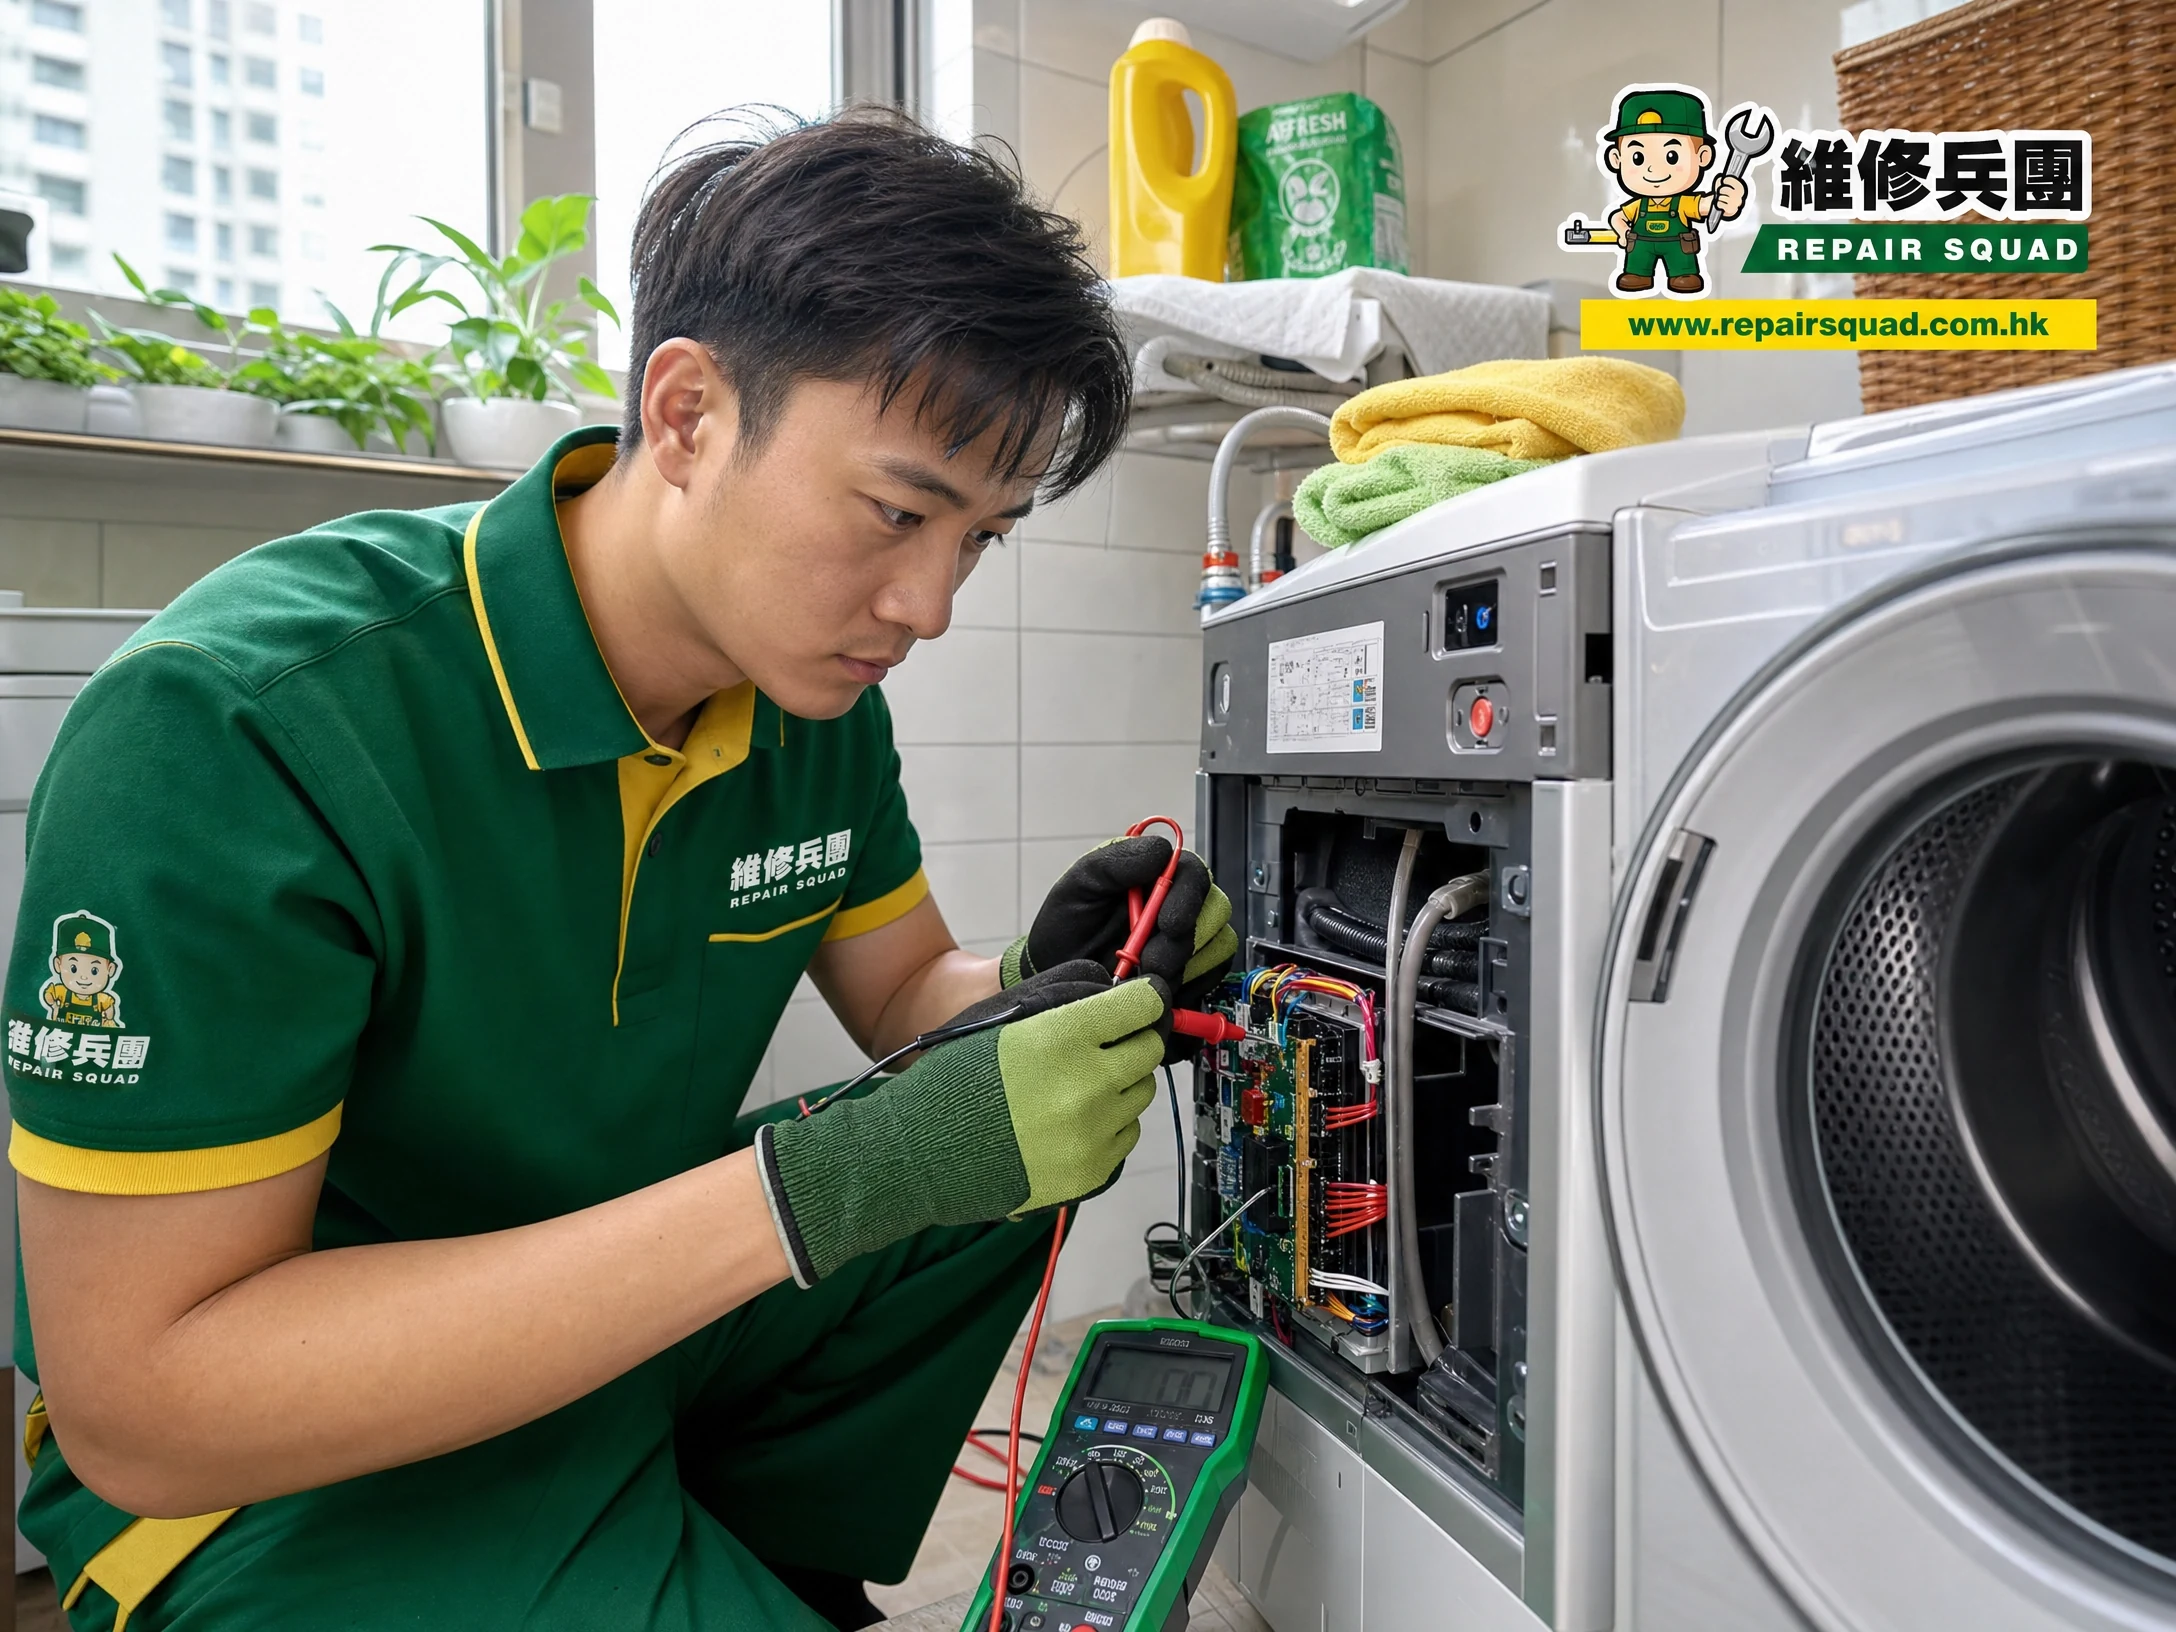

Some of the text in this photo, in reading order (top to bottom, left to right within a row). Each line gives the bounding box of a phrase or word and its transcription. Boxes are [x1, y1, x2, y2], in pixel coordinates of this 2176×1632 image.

[729, 828, 852, 892] 維修兵團
[730, 867, 846, 909] REPAIR SQUAD
[72, 1071, 140, 1084] SQUAD
